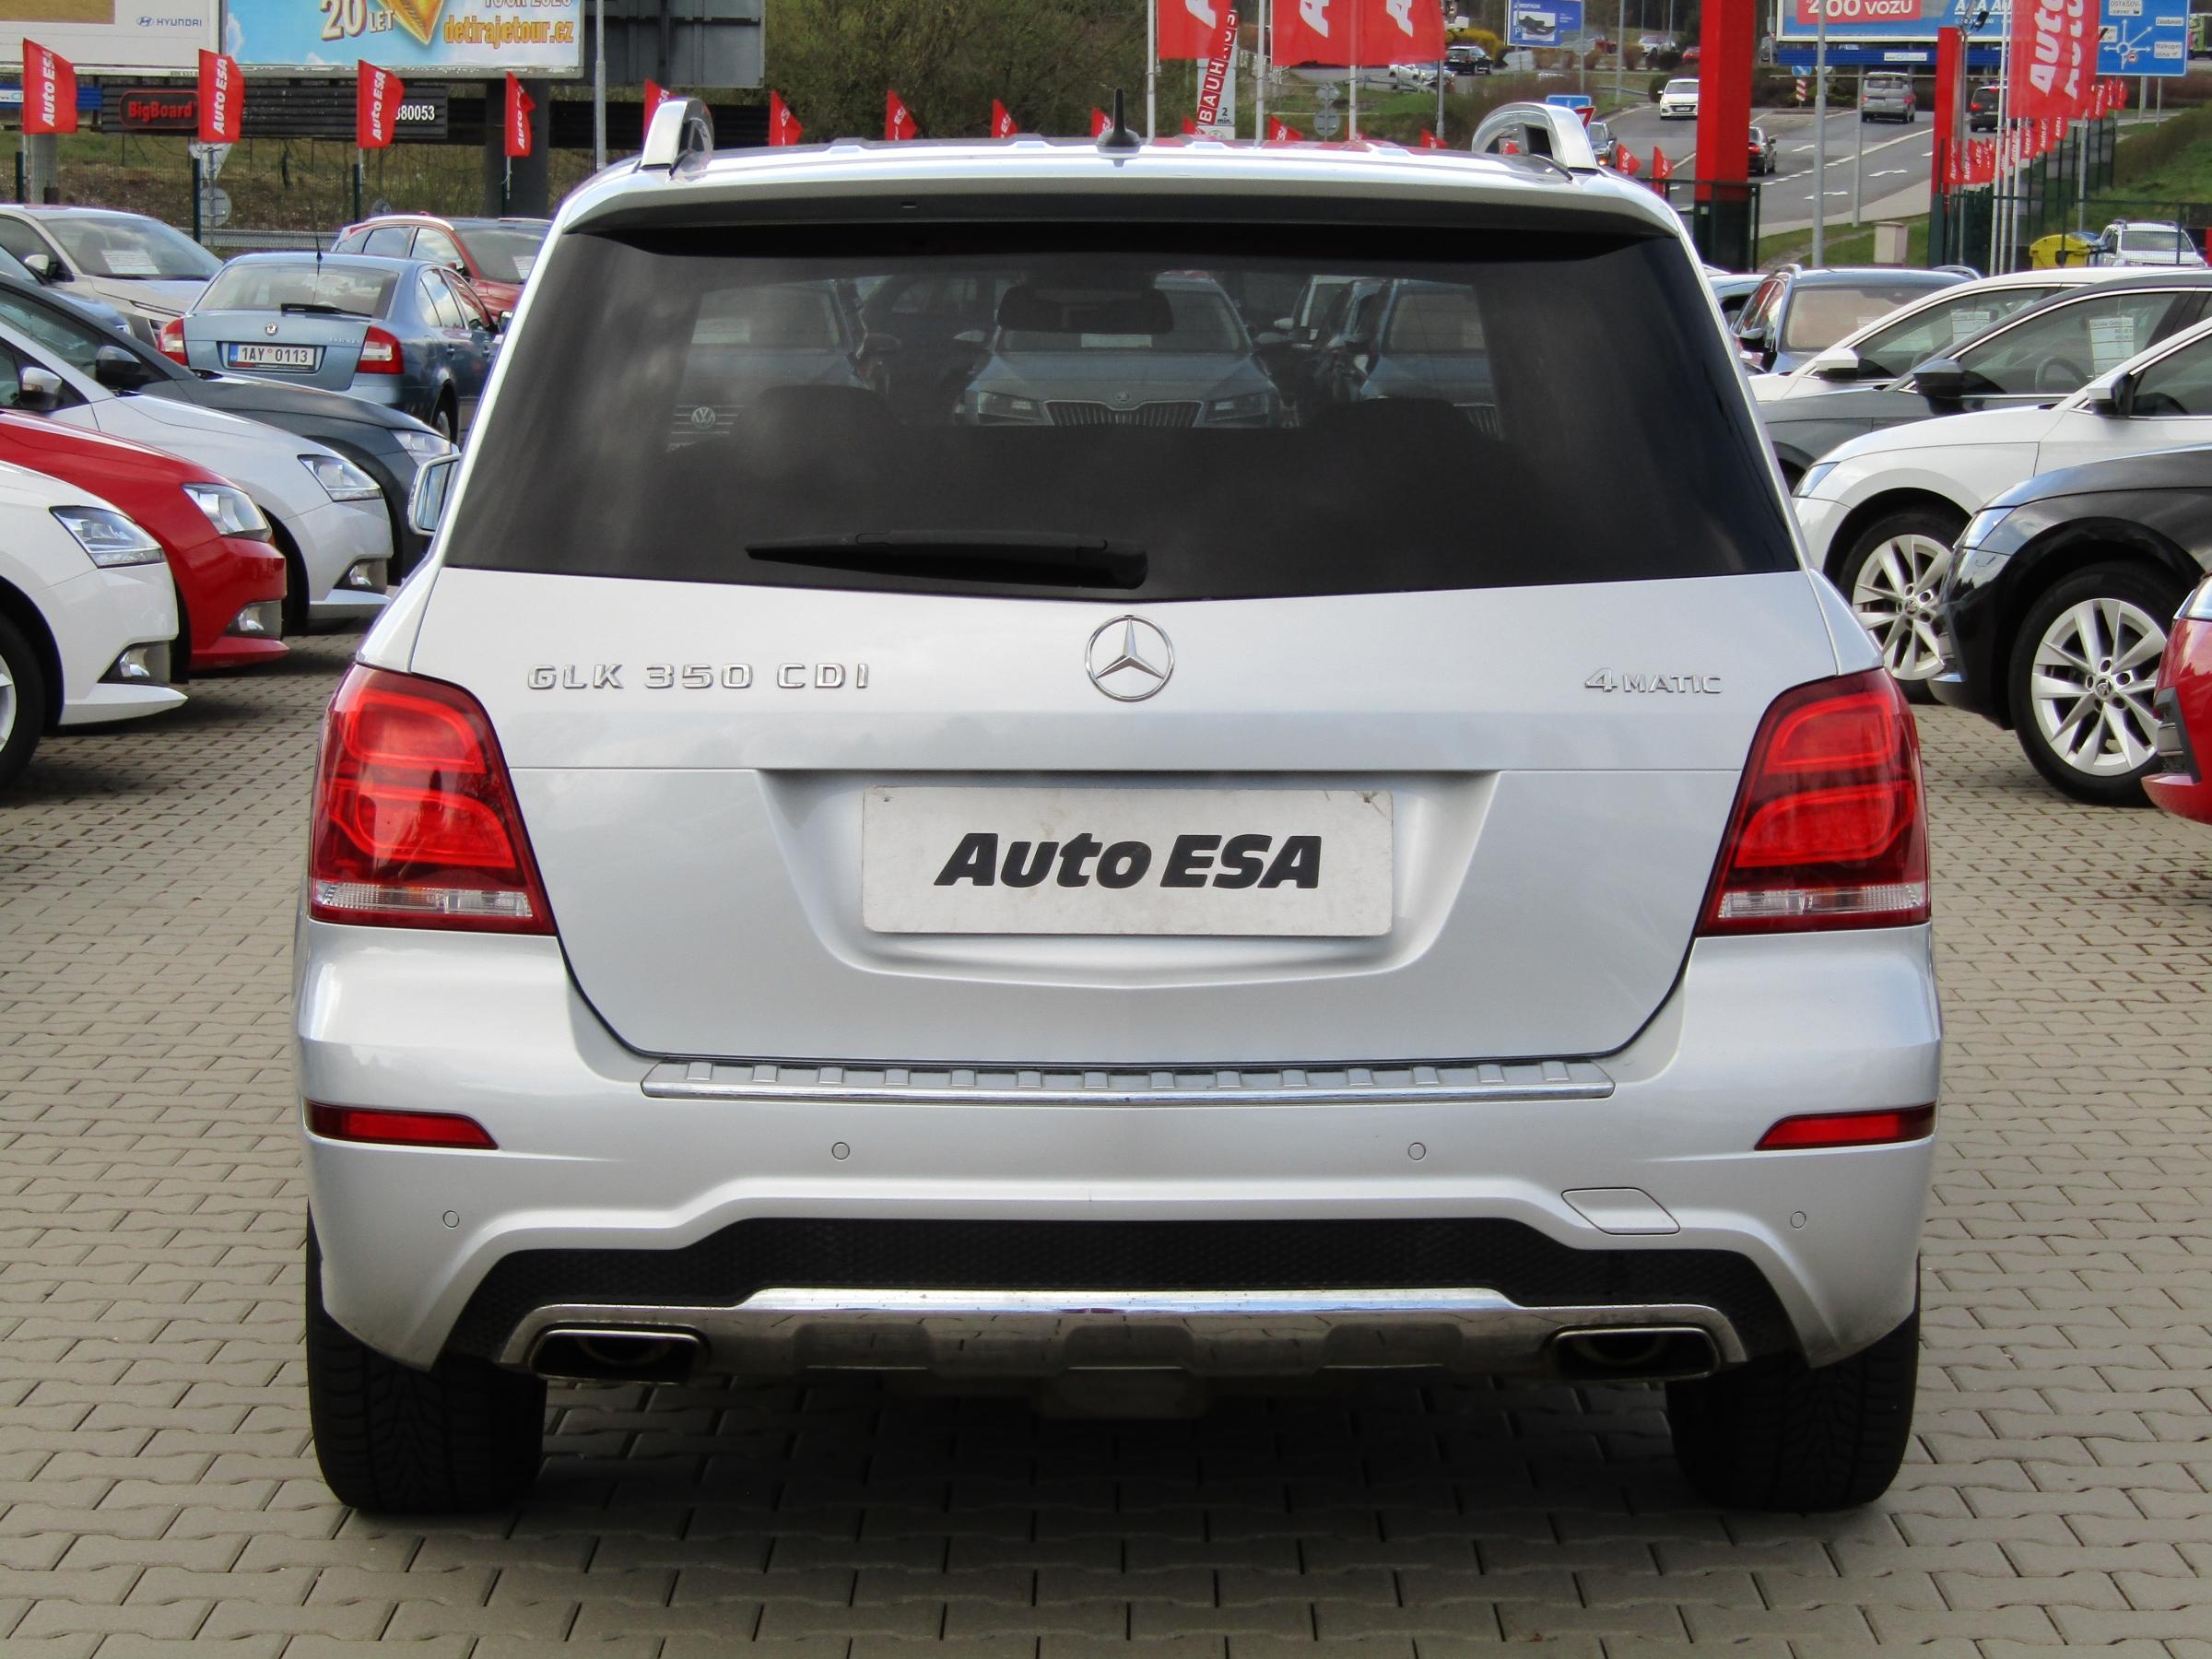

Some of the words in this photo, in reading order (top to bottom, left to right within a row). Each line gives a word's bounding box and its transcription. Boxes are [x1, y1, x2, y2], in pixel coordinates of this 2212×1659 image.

[157, 18, 202, 27] HYUNDAI
[320, 0, 368, 41] 20
[369, 9, 395, 33] LET
[443, 15, 574, 49] detirajetour.cz
[216, 58, 229, 91] ESA
[372, 71, 386, 100] ESA
[41, 82, 55, 127] Auto
[128, 100, 193, 123] BigBoard
[213, 93, 227, 135] Auto
[1221, 107, 1229, 117] 2
[371, 100, 383, 141] Auto
[241, 347, 265, 361] 1AY
[275, 349, 308, 363] 0113
[527, 663, 624, 689] GLK
[644, 663, 752, 689] 350
[776, 663, 869, 689] CDI
[1584, 667, 1723, 694] 4MATIC
[933, 832, 1151, 888] Auto
[1159, 834, 1322, 888] ESA
